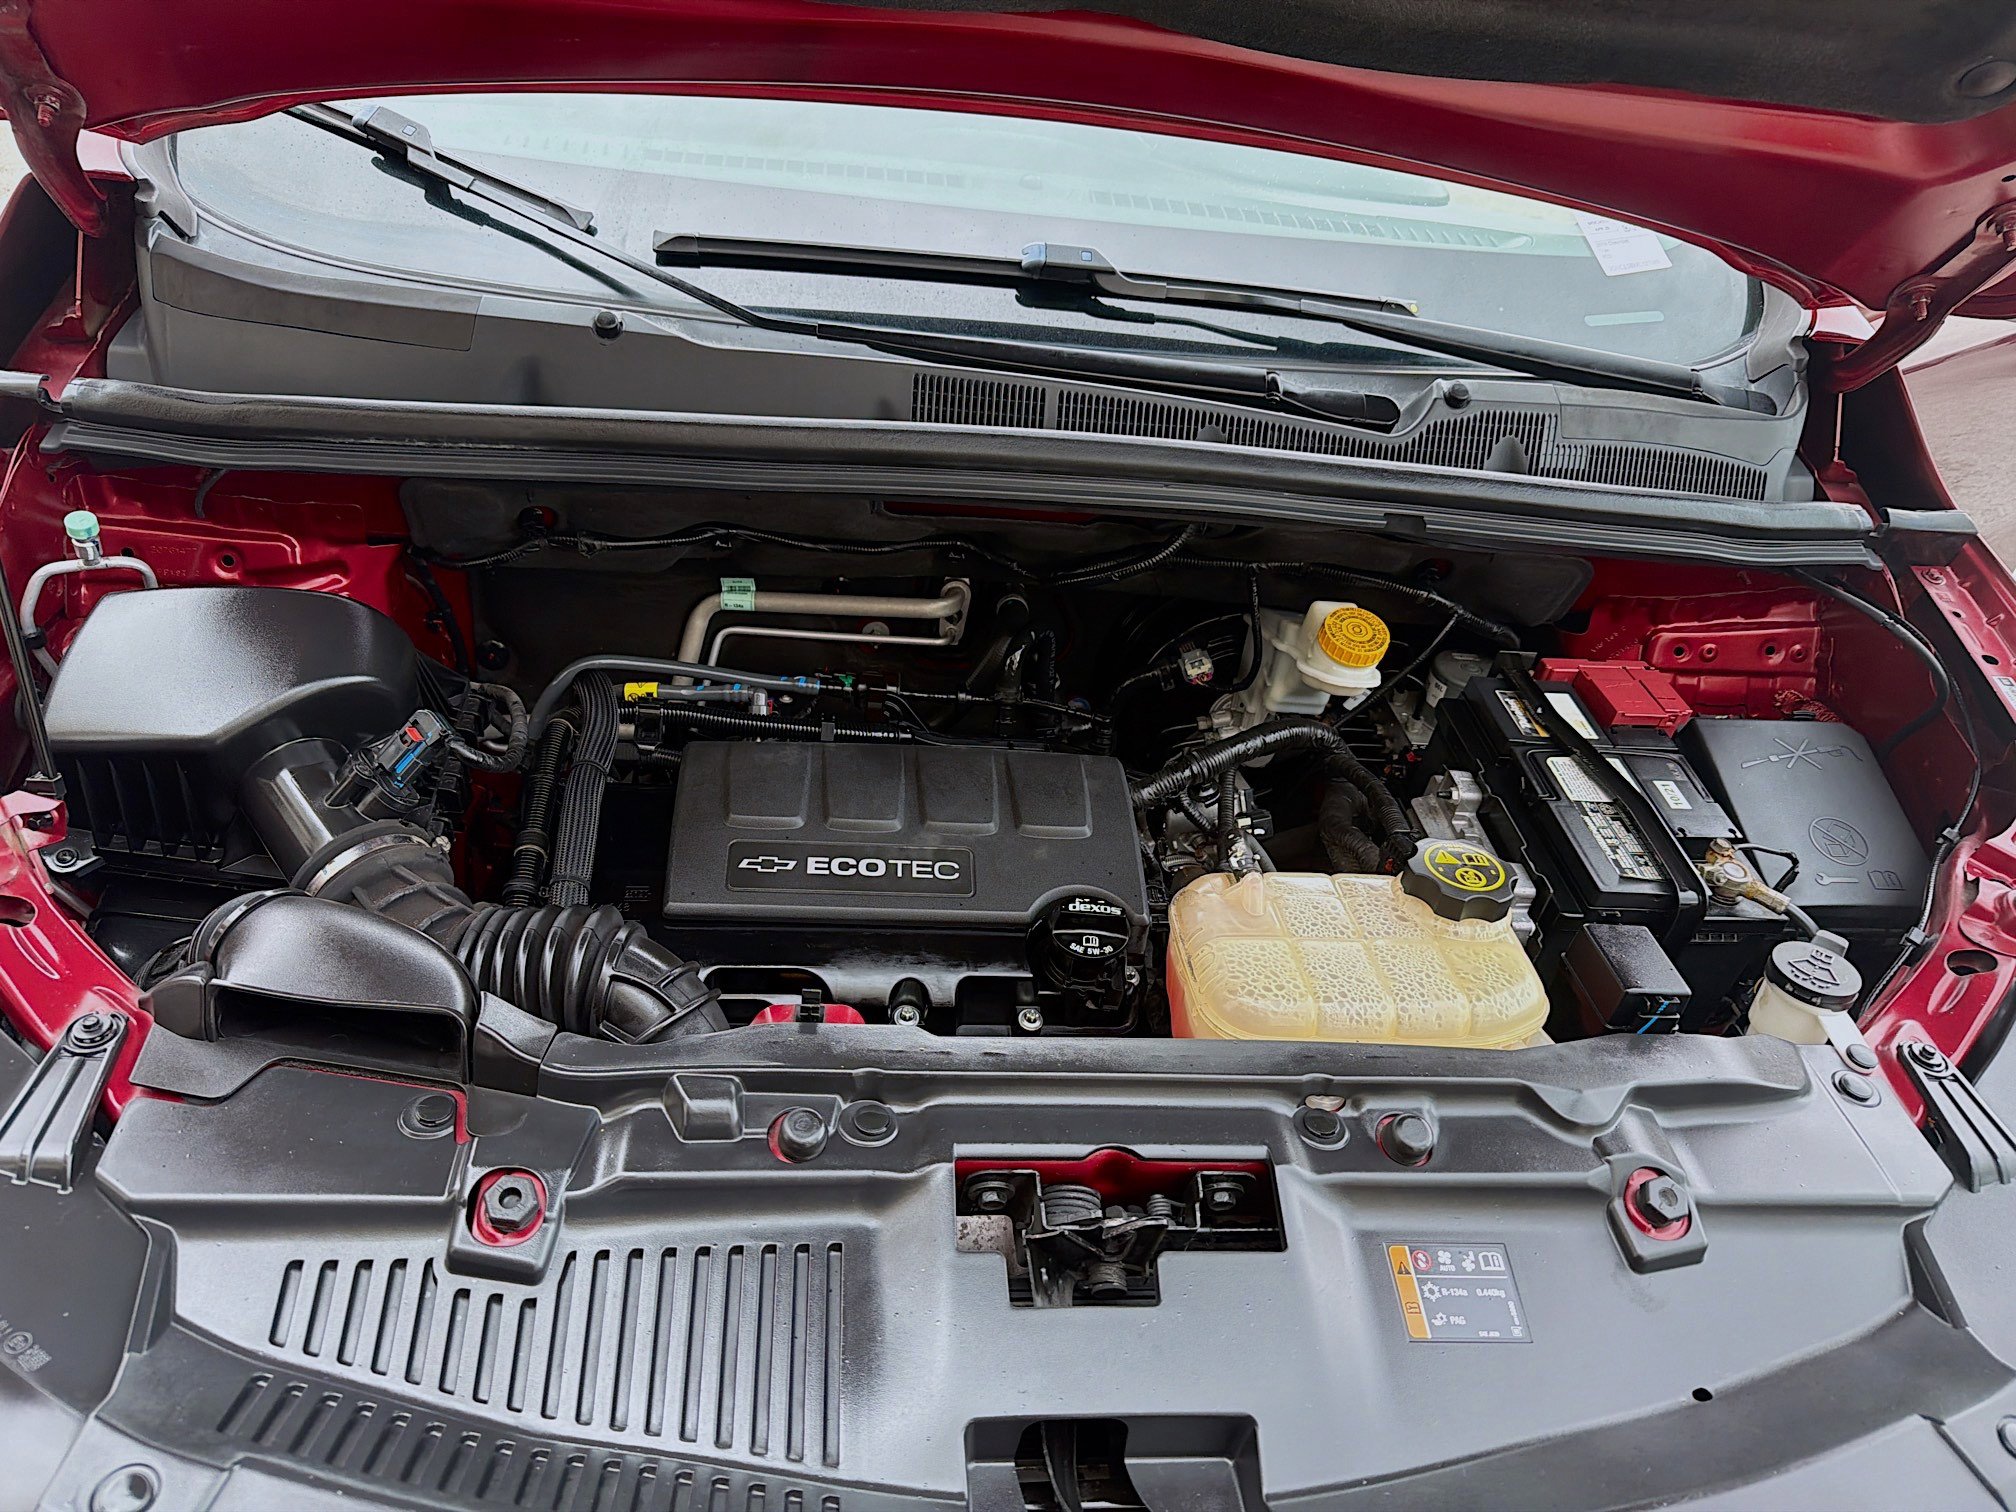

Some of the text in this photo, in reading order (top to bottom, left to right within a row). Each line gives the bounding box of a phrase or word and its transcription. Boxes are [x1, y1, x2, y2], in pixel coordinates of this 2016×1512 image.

[806, 856, 960, 880] ECOTEC
[1068, 899, 1123, 915] dexos
[1069, 942, 1114, 955] SAE 5W-30
[1440, 1264, 1456, 1272] AUTO
[1441, 1288, 1468, 1297] R-134a
[1449, 1315, 1467, 1326] PAG
